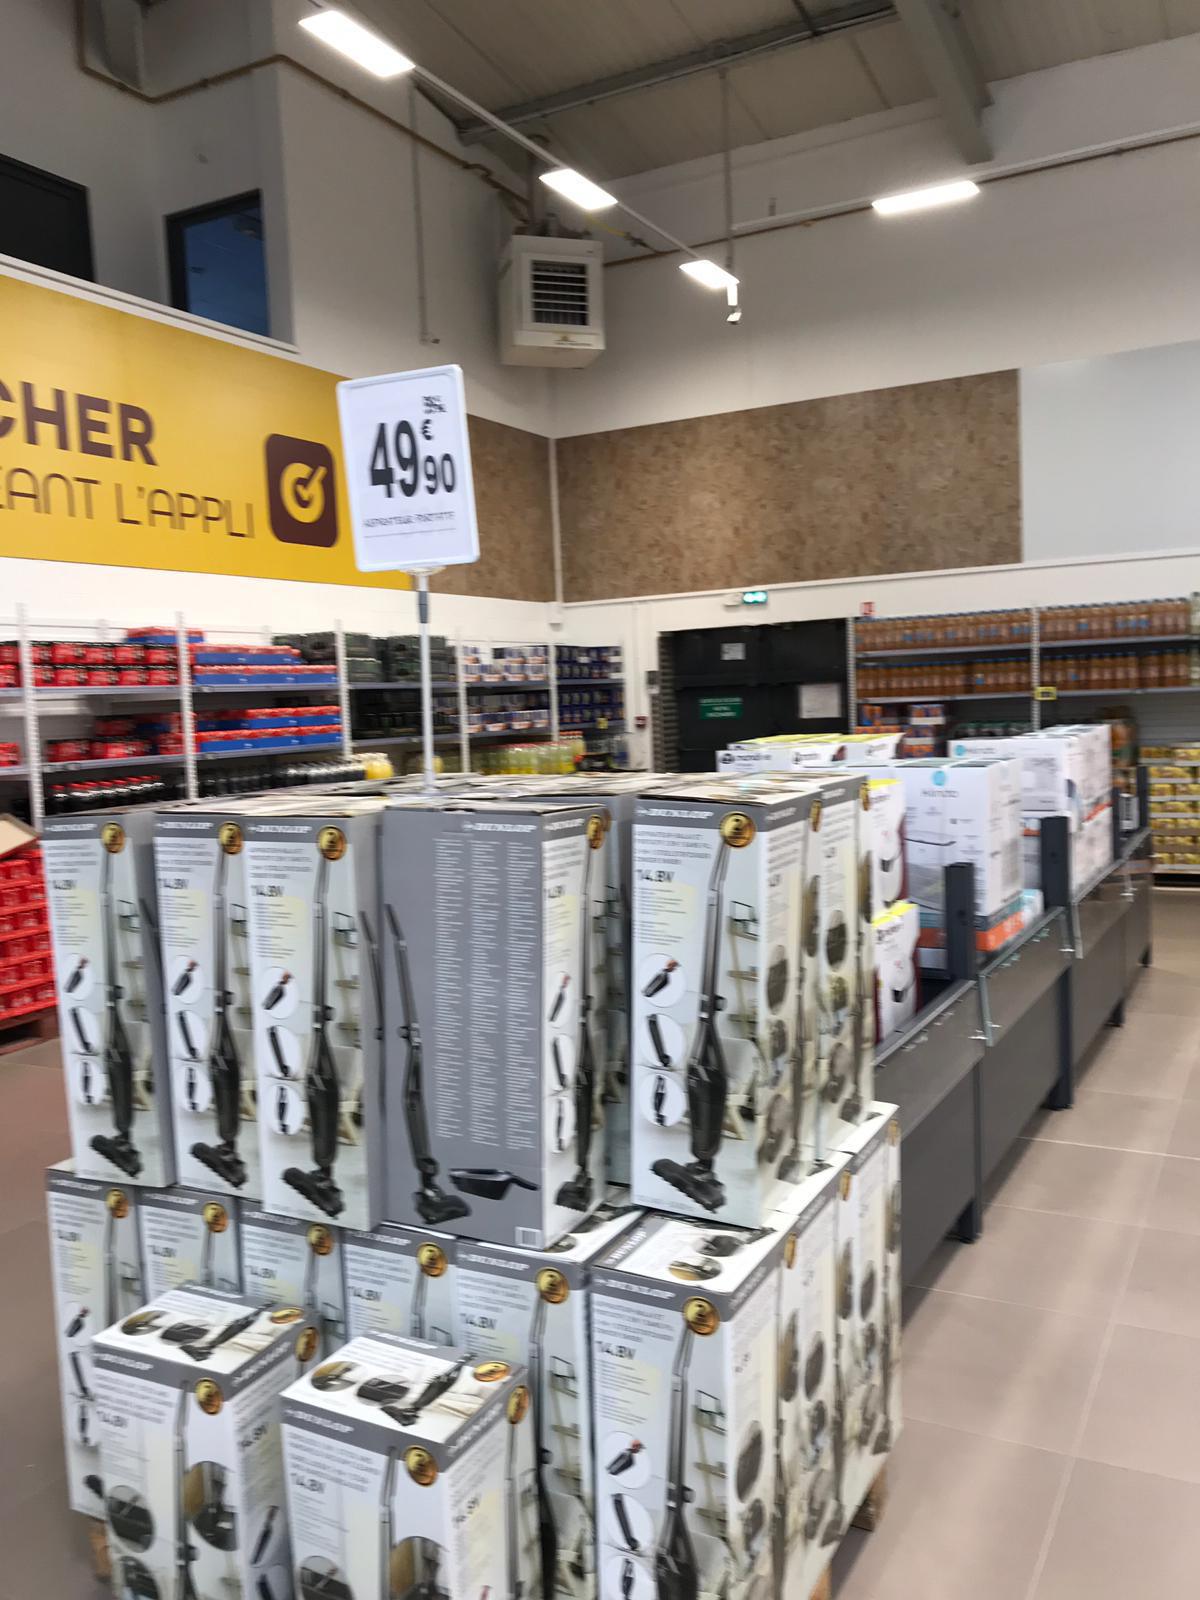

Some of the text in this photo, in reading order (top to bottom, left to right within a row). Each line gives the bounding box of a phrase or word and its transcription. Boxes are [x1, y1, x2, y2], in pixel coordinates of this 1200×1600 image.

[371, 418, 455, 499] 49 € 90
[0, 467, 255, 538] ANT L'APPLI
